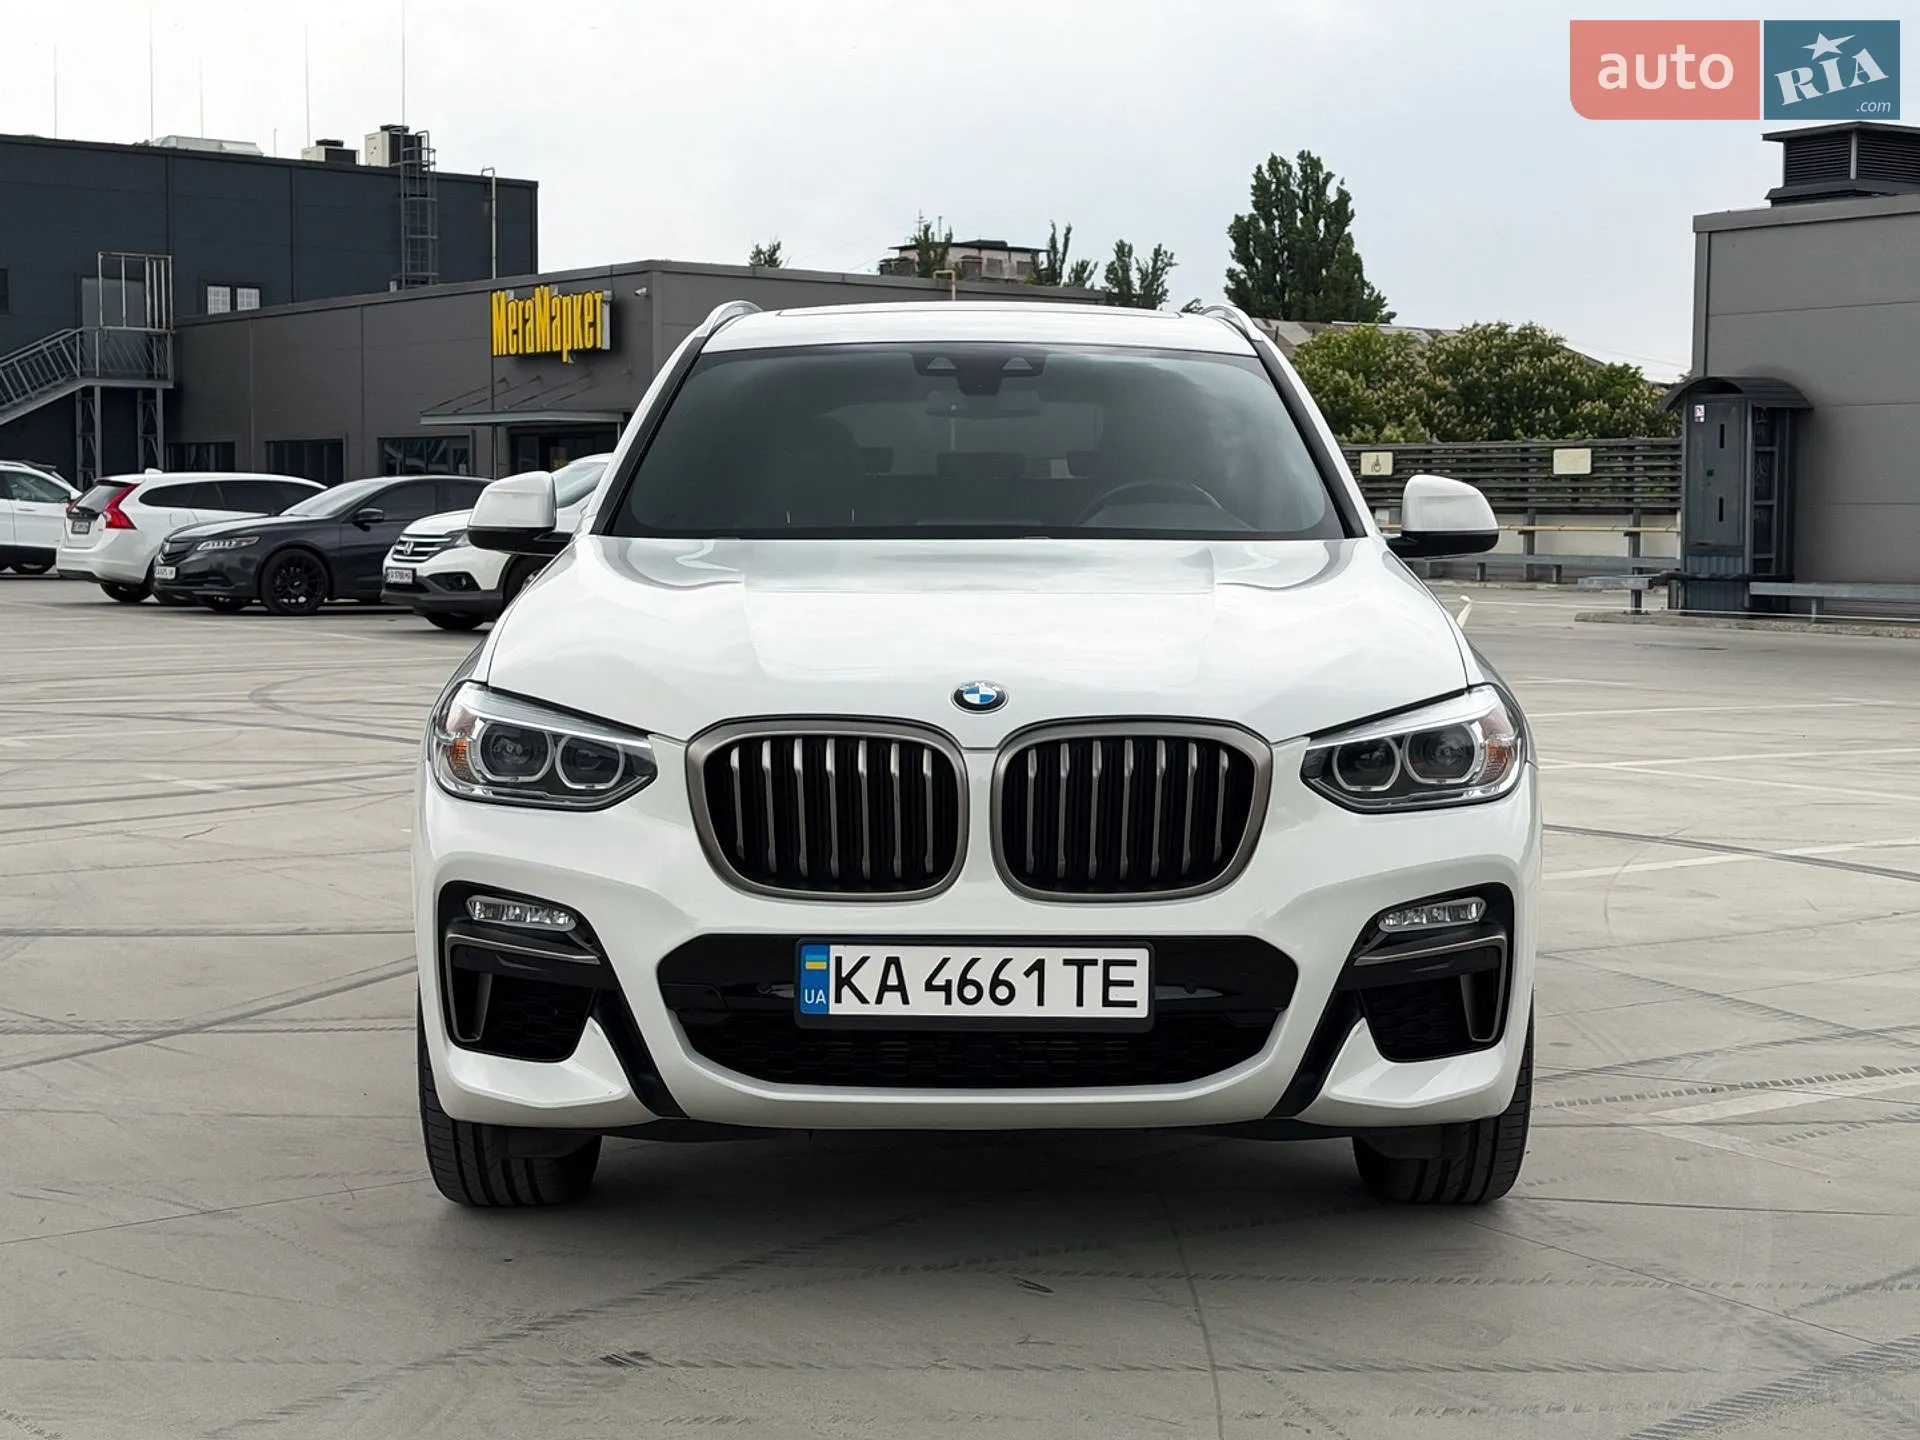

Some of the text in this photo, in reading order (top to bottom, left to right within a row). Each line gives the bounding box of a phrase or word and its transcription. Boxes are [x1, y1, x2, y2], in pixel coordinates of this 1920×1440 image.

[491, 285, 603, 363] МегаМаркет
[804, 989, 827, 1005] UA
[834, 955, 1138, 1008] KA 4661 TE
